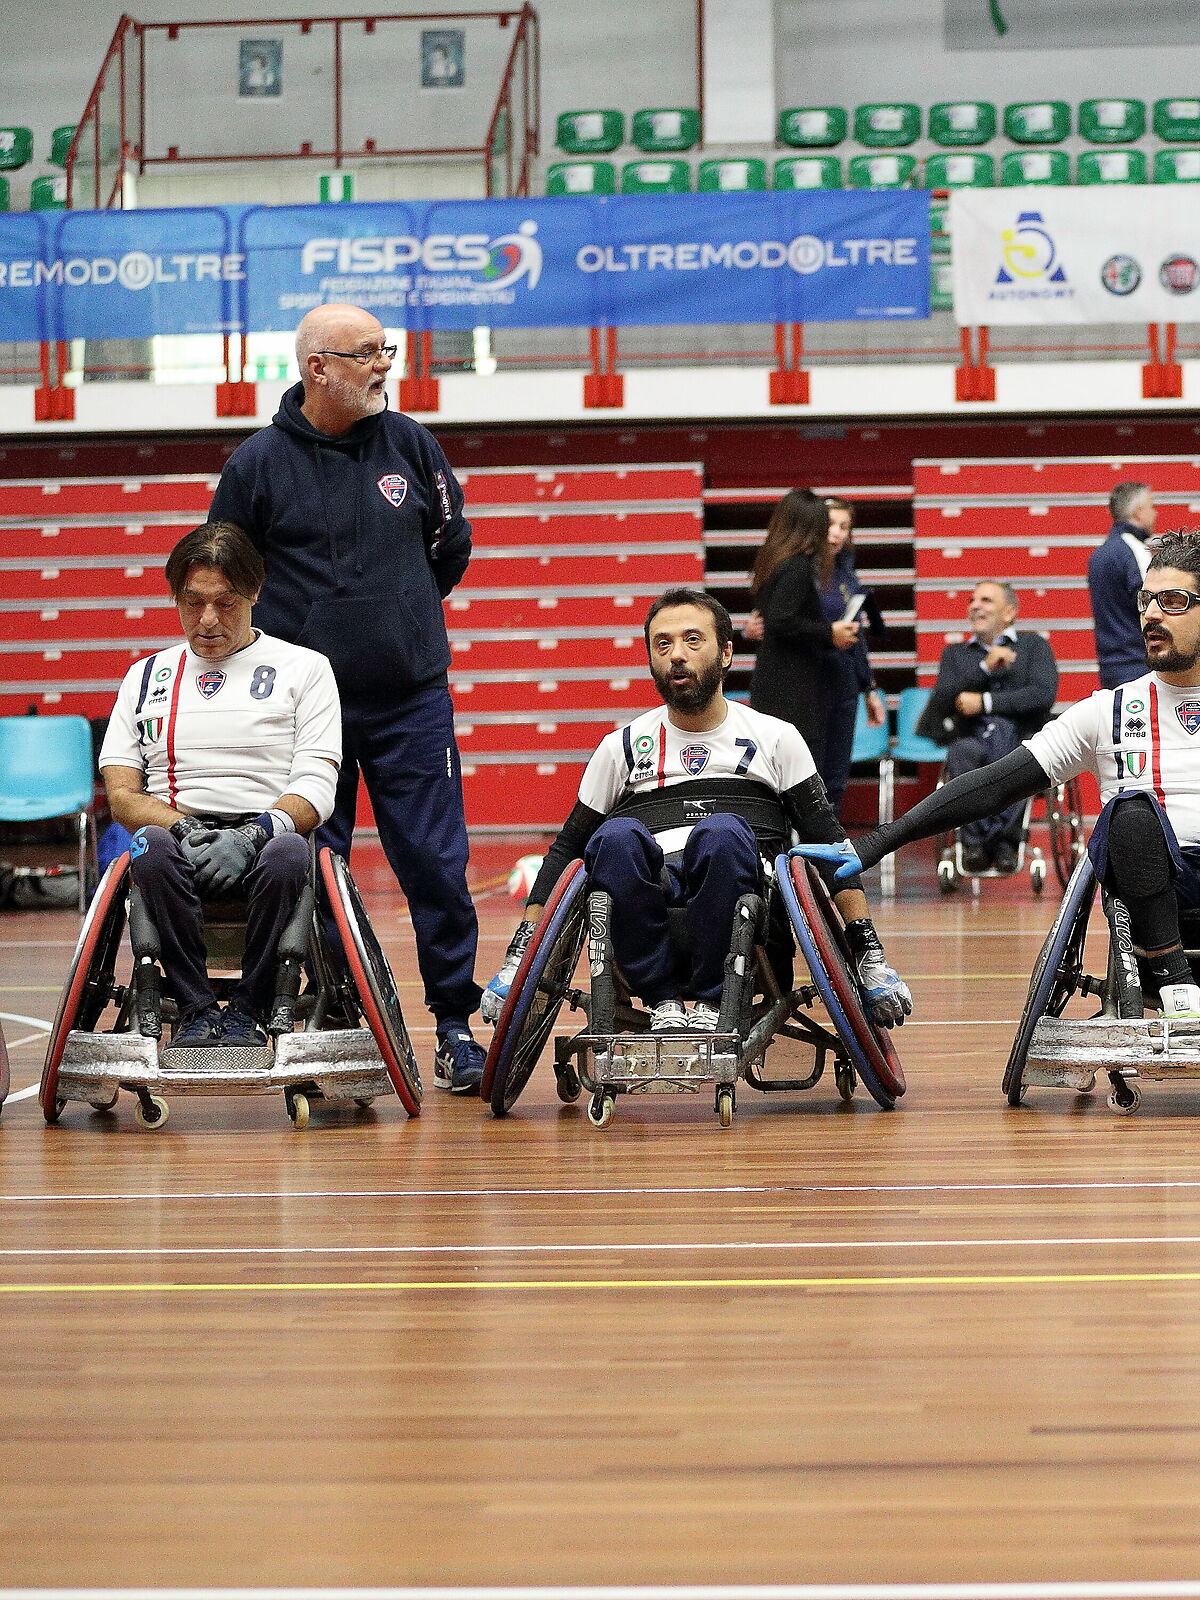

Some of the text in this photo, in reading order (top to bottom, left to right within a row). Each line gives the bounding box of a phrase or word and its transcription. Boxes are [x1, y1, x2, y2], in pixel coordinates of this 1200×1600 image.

[0, 251, 247, 290] EMODOLTRE
[303, 234, 490, 275] FISPES
[988, 288, 1076, 300] AUTONOMY
[250, 665, 277, 700] 8
[735, 737, 757, 774] 7
